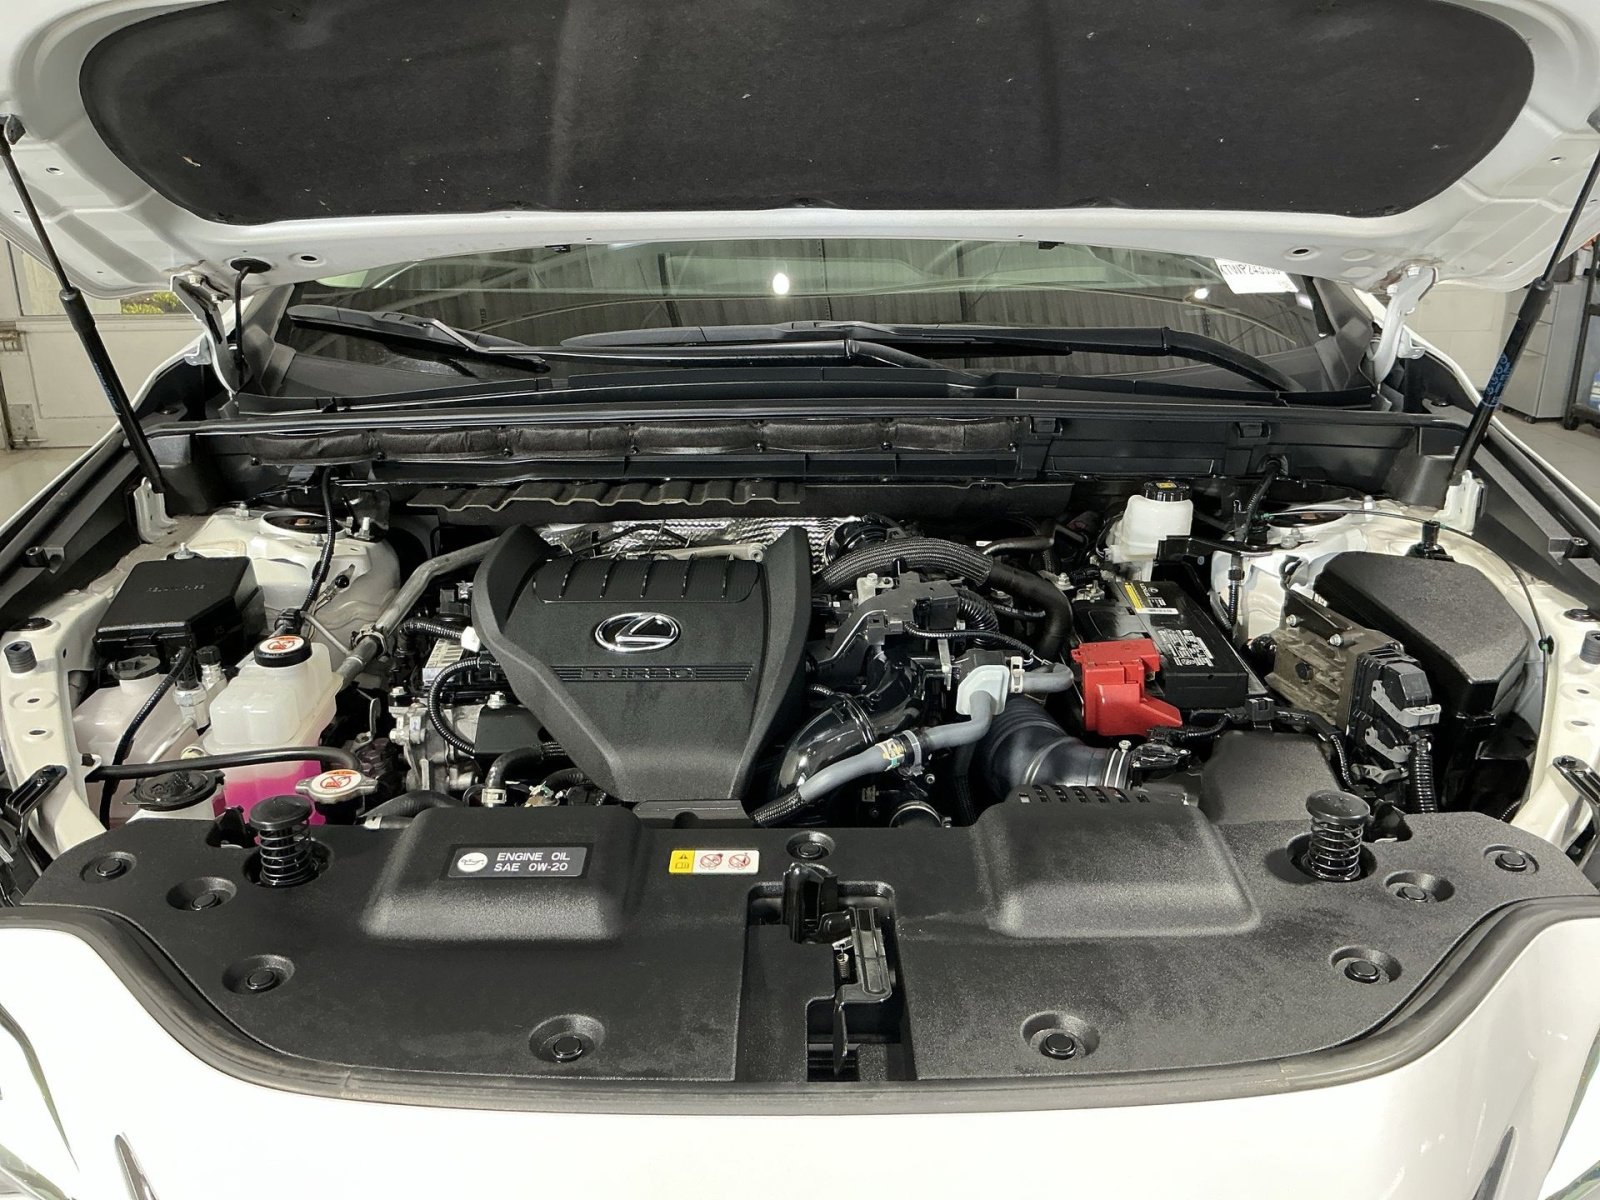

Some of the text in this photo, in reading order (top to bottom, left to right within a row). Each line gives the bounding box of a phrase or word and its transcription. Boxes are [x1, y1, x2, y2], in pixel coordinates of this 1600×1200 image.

[585, 667, 694, 679] TURBO
[496, 852, 571, 861] ENGINE OIL
[493, 862, 569, 872] SAE 0W-20
